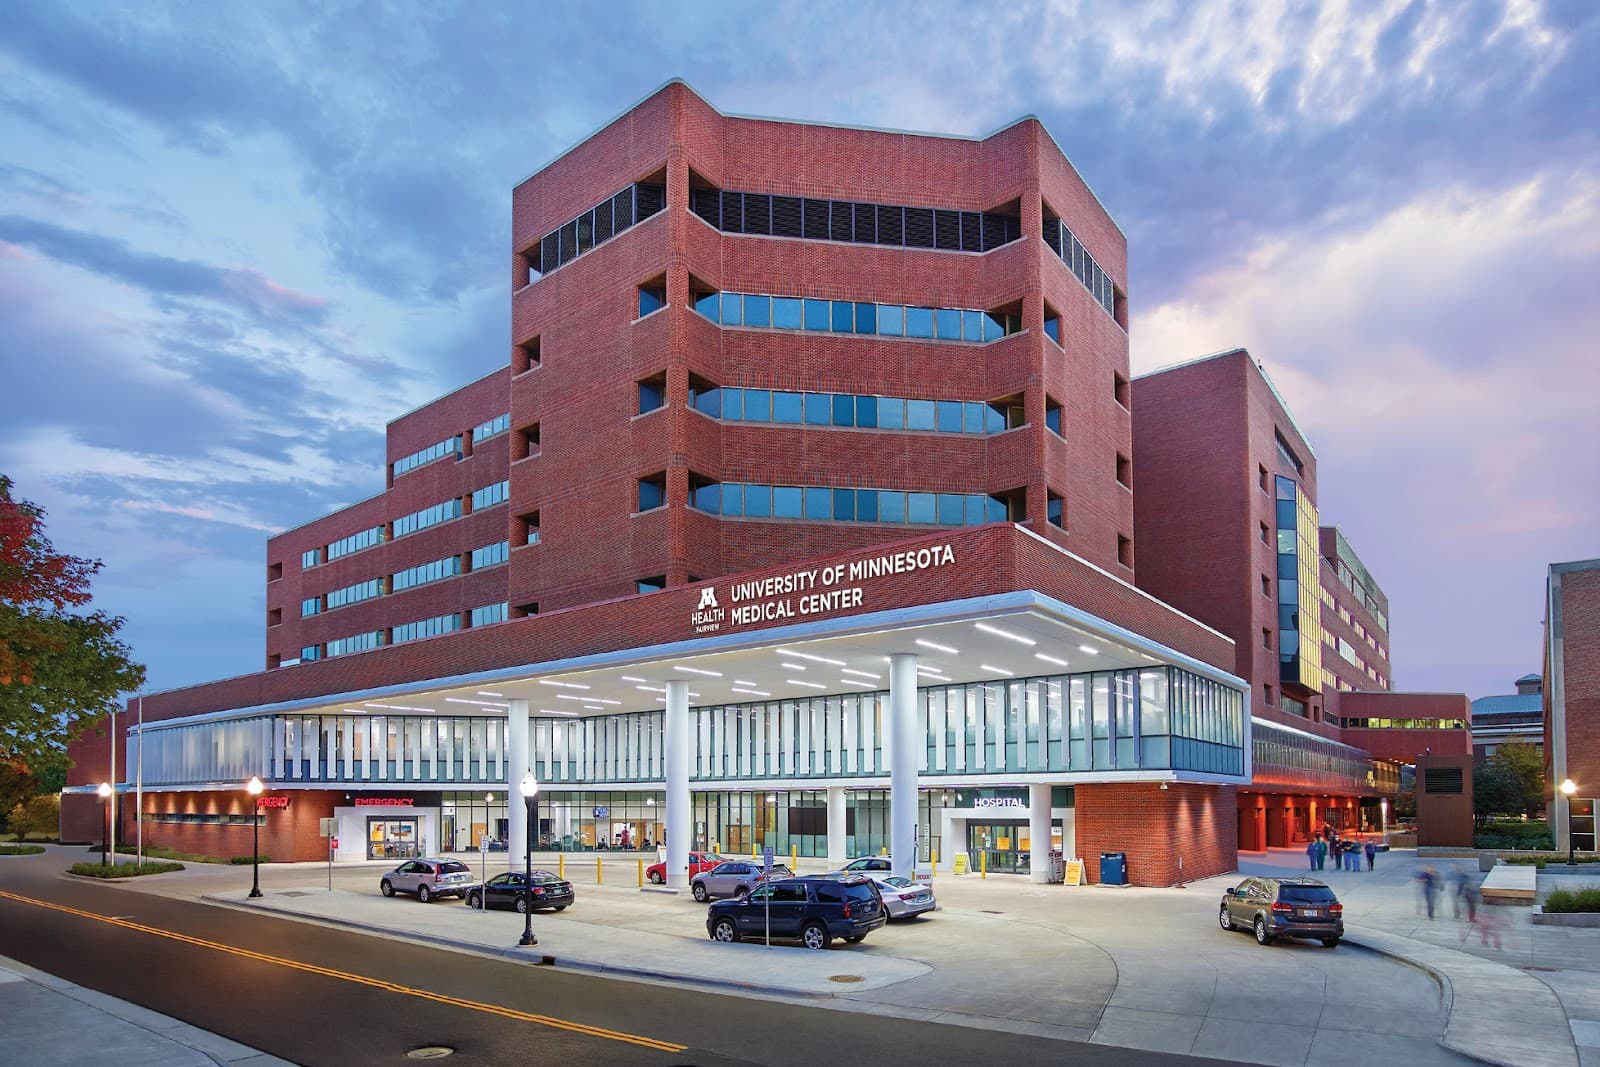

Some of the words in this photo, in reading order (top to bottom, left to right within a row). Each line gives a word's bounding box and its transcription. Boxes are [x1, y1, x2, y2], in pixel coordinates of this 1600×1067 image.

[731, 569, 818, 602] UNIVERSITY
[822, 564, 845, 586] OF
[849, 544, 956, 581] MINNESOTA
[731, 599, 795, 626] MEDICAL
[799, 587, 863, 614] CENTER
[691, 607, 725, 625] HEALTH
[696, 623, 720, 634] FAIRVIEW
[255, 796, 289, 808] MERGENCY
[354, 798, 414, 807] EMERGENCY
[974, 797, 1026, 809] HOSPITAL
